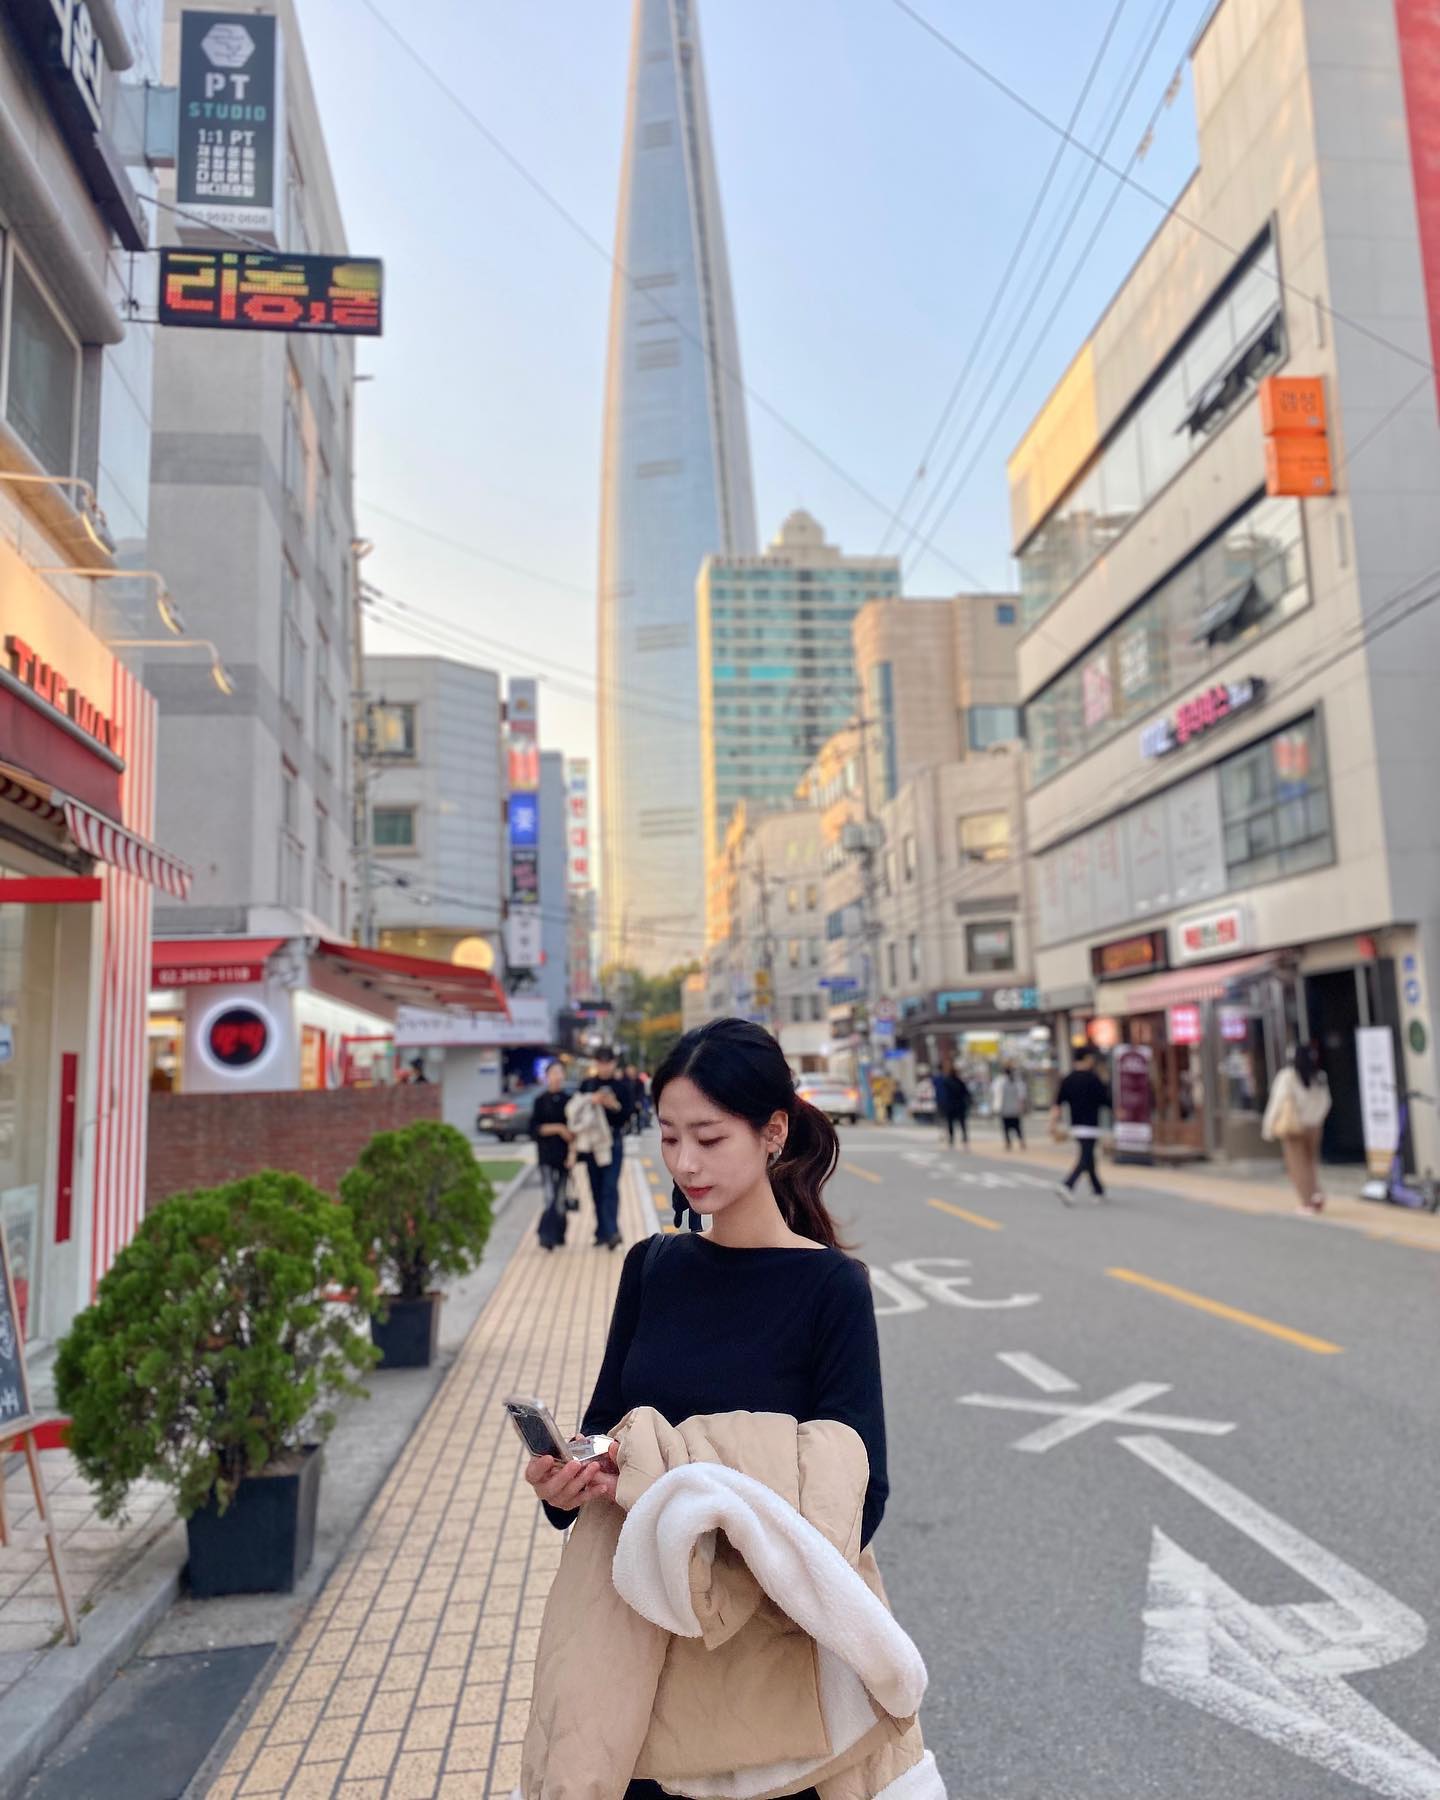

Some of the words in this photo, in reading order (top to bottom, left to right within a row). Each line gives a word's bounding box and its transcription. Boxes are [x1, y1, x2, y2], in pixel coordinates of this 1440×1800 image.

[205, 72, 250, 100] PT
[188, 101, 267, 122] STUDIO
[198, 128, 224, 144] 1:1
[230, 129, 256, 146] PT
